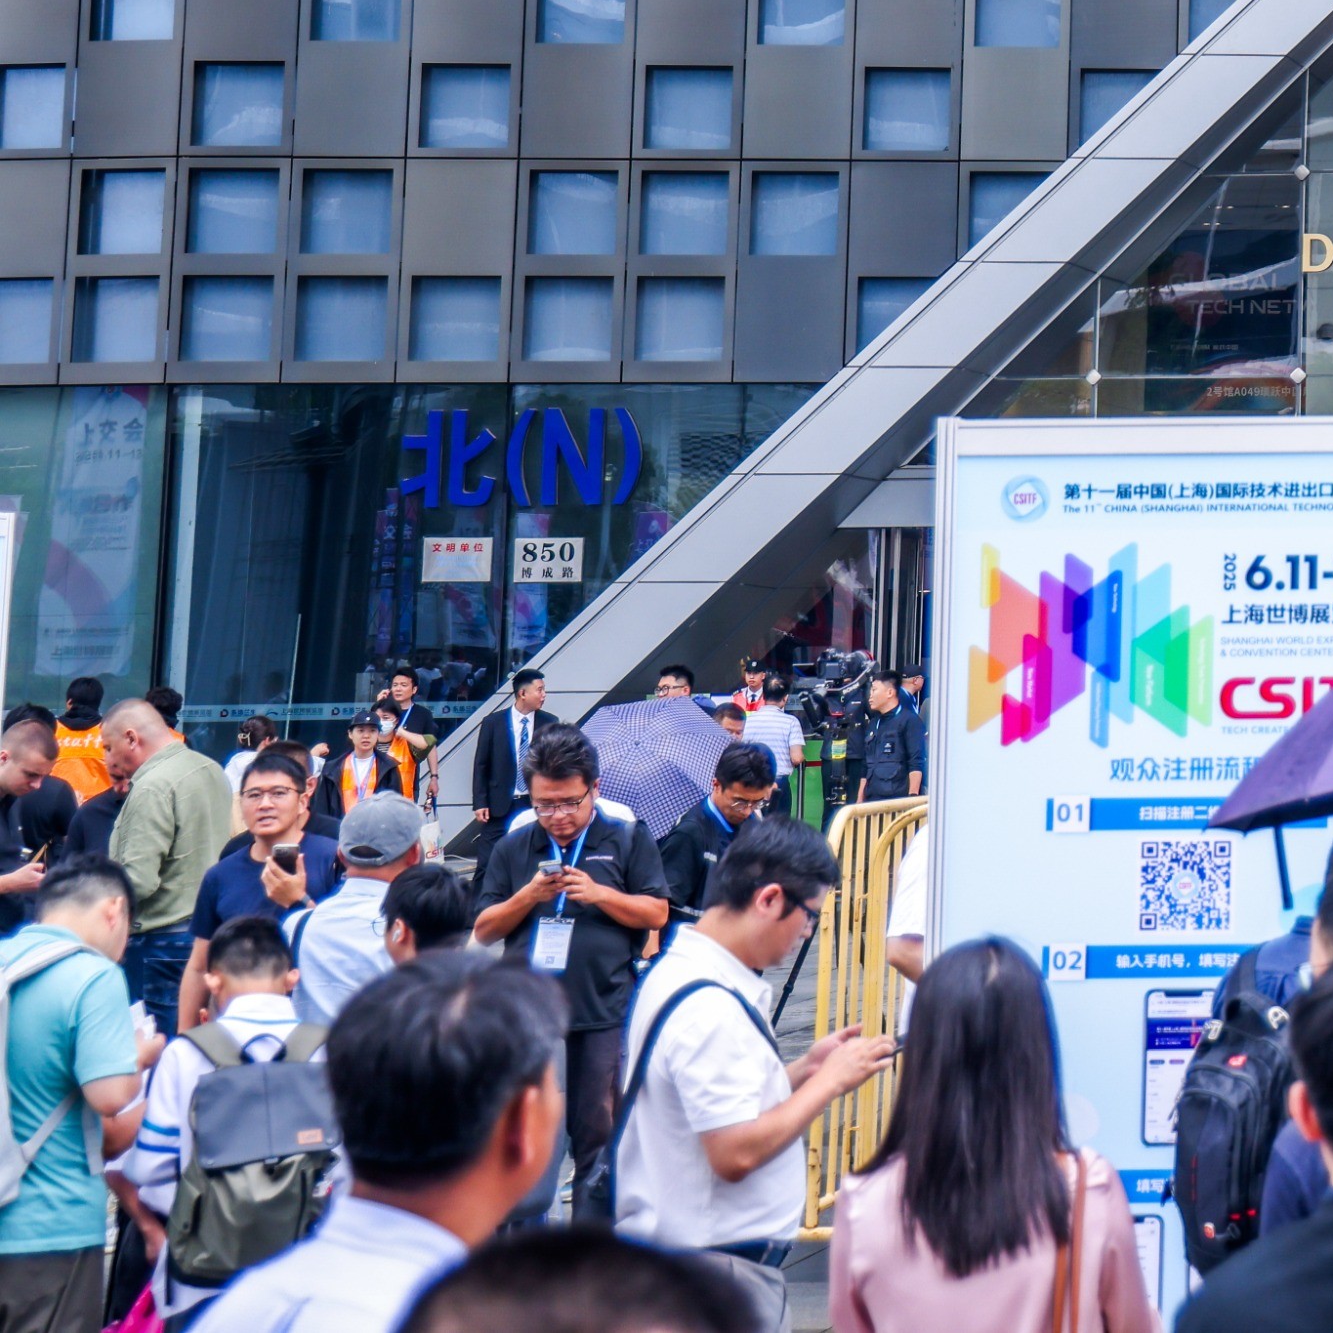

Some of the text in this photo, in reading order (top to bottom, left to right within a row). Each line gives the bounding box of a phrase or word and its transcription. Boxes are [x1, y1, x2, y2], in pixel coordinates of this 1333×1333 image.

[400, 407, 642, 508] 北(N)
[1013, 493, 1037, 505] CSITF
[1062, 504, 1080, 514] The
[1105, 504, 1138, 514] CHINA
[1140, 504, 1204, 514] (SHANGHAI)
[1206, 503, 1289, 512] INTERNATIONAL
[432, 542, 484, 554] 文明单位
[521, 542, 575, 563] 850
[520, 567, 574, 579] 博成路
[1223, 553, 1237, 591] 2025
[1220, 636, 1274, 646] SHANGHAI
[1276, 636, 1314, 645] WORLD
[1220, 648, 1227, 657] &
[1230, 647, 1298, 657] CONVENTION
[1221, 726, 1248, 734] TECH
[1056, 803, 1085, 823] 01
[1052, 950, 1083, 972] 02
